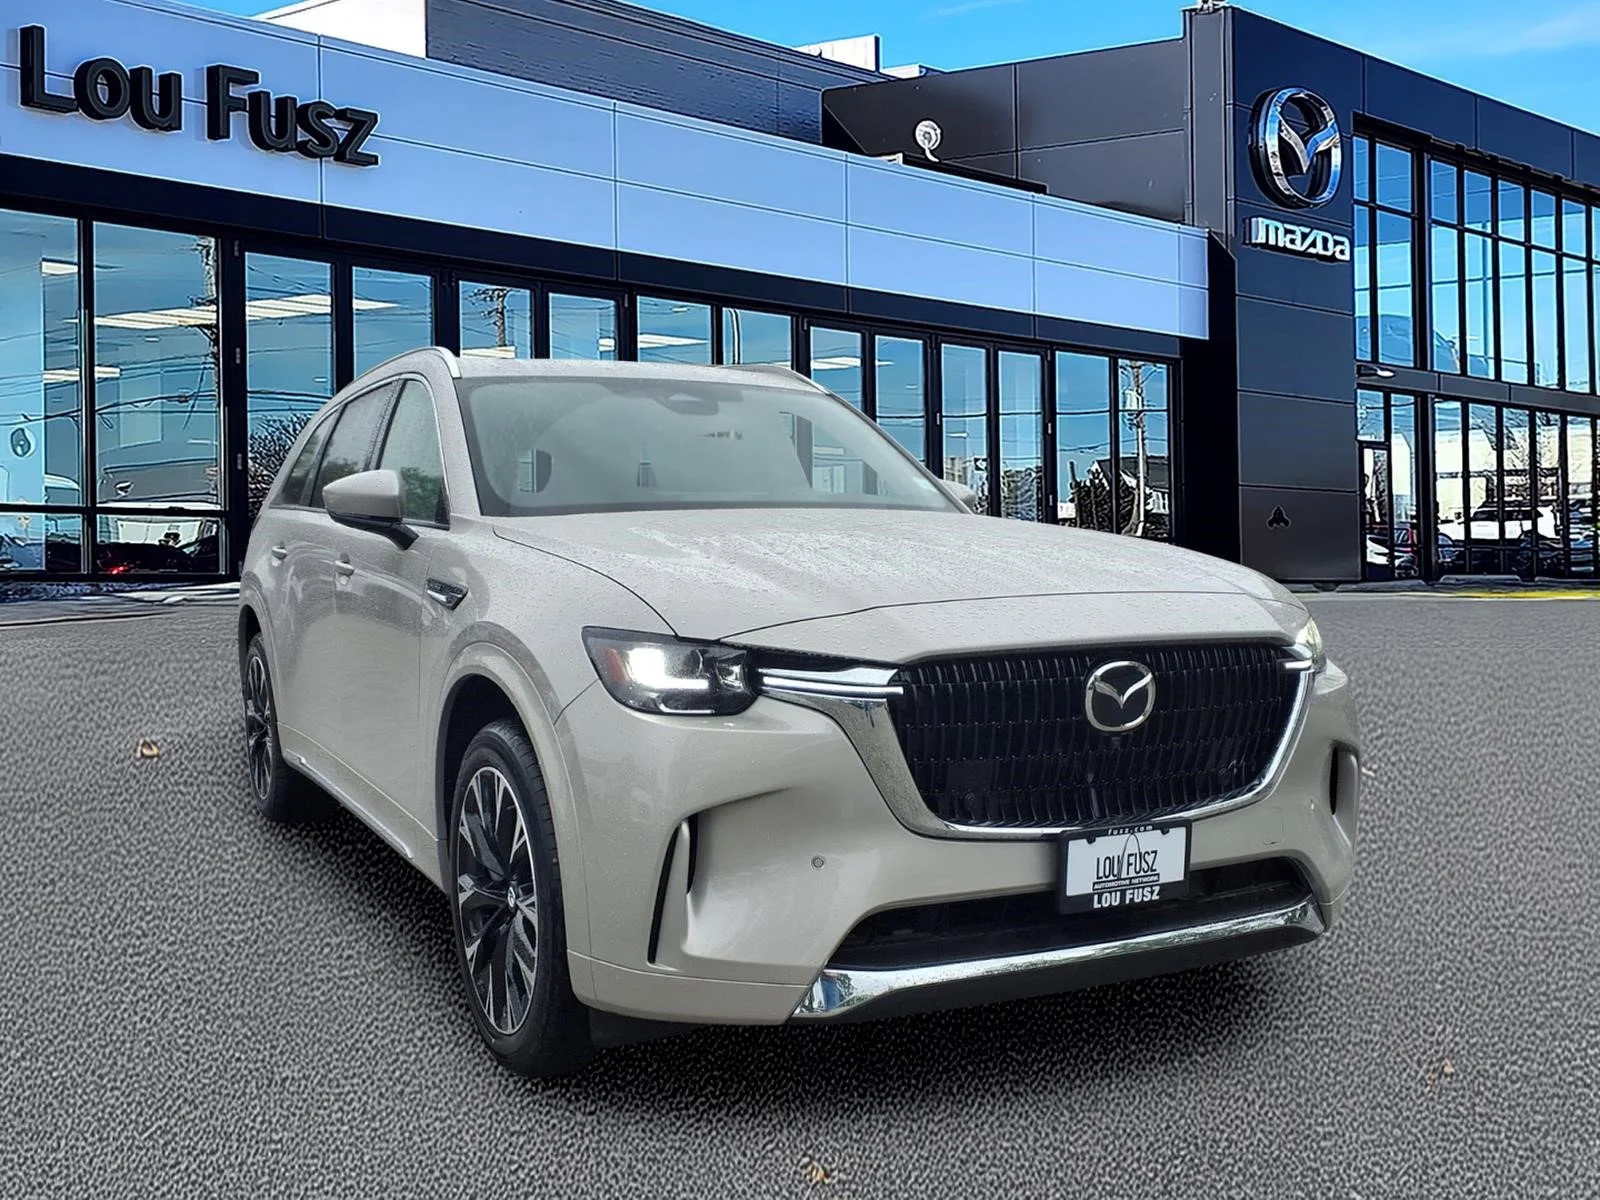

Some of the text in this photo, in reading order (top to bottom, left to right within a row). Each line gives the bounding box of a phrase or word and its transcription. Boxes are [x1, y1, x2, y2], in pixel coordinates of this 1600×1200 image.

[18, 25, 380, 166] Lou Fusz
[1107, 826, 1153, 835] fusz.com
[1096, 850, 1158, 880] LOU FUSZ
[1094, 880, 1130, 889] AUTOMOTIVE
[1093, 886, 1160, 909] LOU FUSZ
